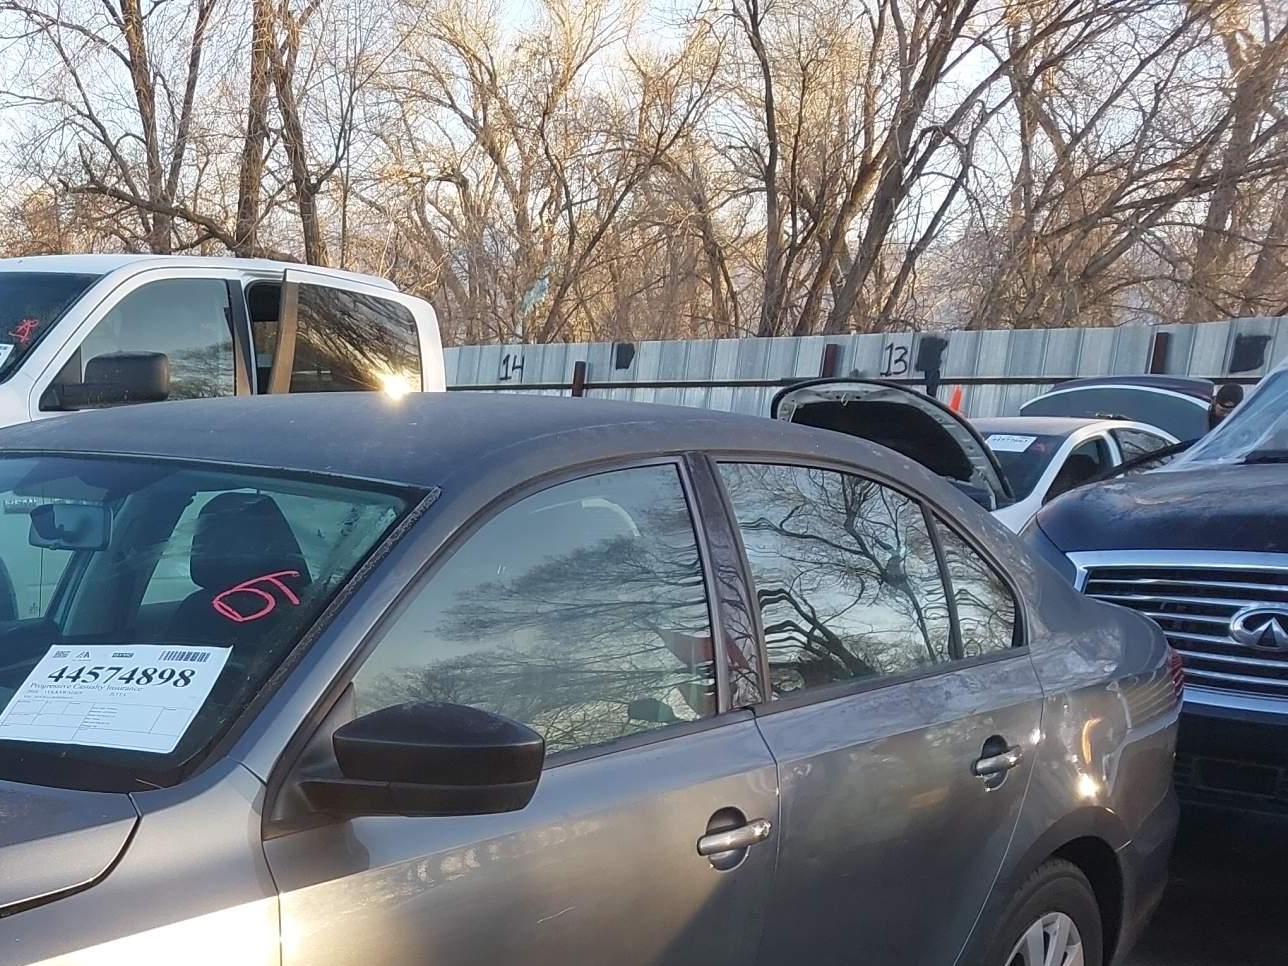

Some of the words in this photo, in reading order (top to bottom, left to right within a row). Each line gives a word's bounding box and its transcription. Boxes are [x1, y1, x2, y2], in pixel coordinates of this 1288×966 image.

[499, 354, 525, 383] 14
[880, 342, 908, 377] 13
[30, 682, 72, 691] Progressive
[73, 683, 103, 691] Casualty
[48, 665, 196, 688] 44574898
